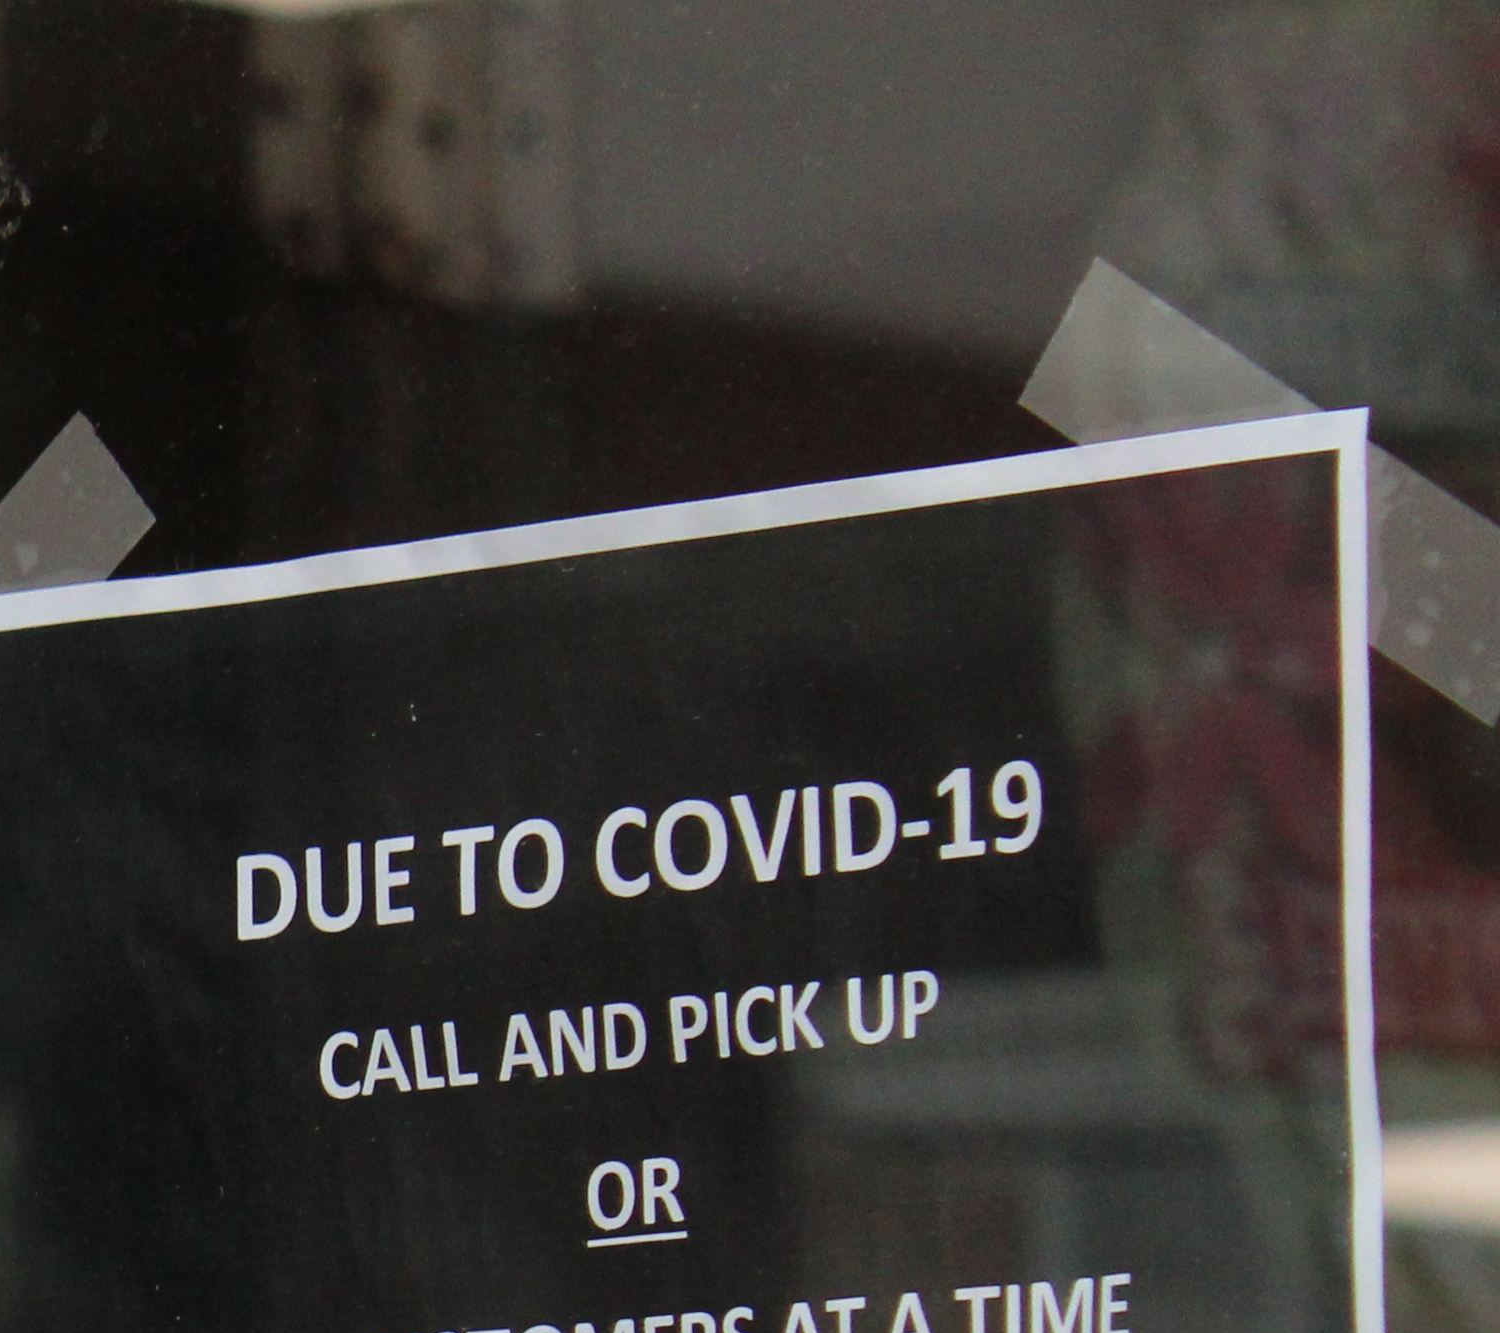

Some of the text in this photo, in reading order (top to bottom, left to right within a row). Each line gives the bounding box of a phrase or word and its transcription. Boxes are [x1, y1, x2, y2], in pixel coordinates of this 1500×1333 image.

[237, 761, 1041, 940] DUE TO COVID-19
[320, 971, 938, 1099] CALL AND PICK UP
[588, 1158, 687, 1236] OR
